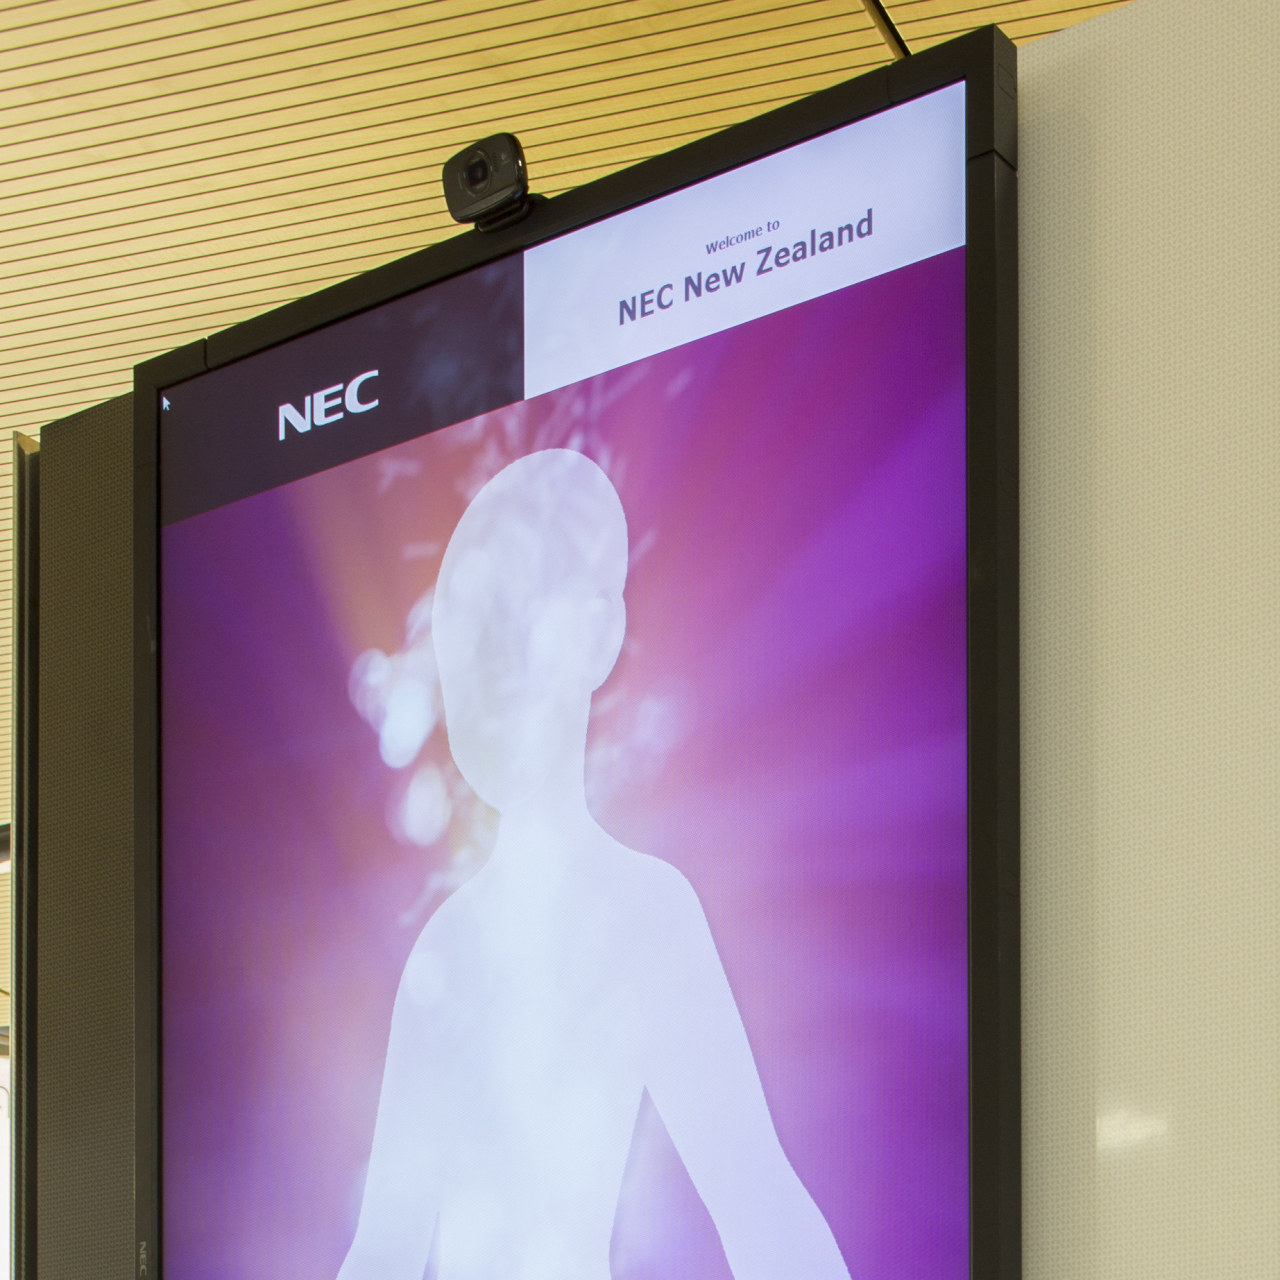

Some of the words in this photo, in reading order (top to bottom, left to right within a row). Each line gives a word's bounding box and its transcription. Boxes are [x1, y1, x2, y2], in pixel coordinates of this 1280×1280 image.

[706, 225, 763, 255] Welcome
[767, 219, 780, 233] to
[619, 283, 674, 326] NEC
[684, 262, 746, 302] New
[756, 208, 873, 276] Zealand
[278, 369, 379, 441] NEC
[139, 1241, 148, 1277] NEC
